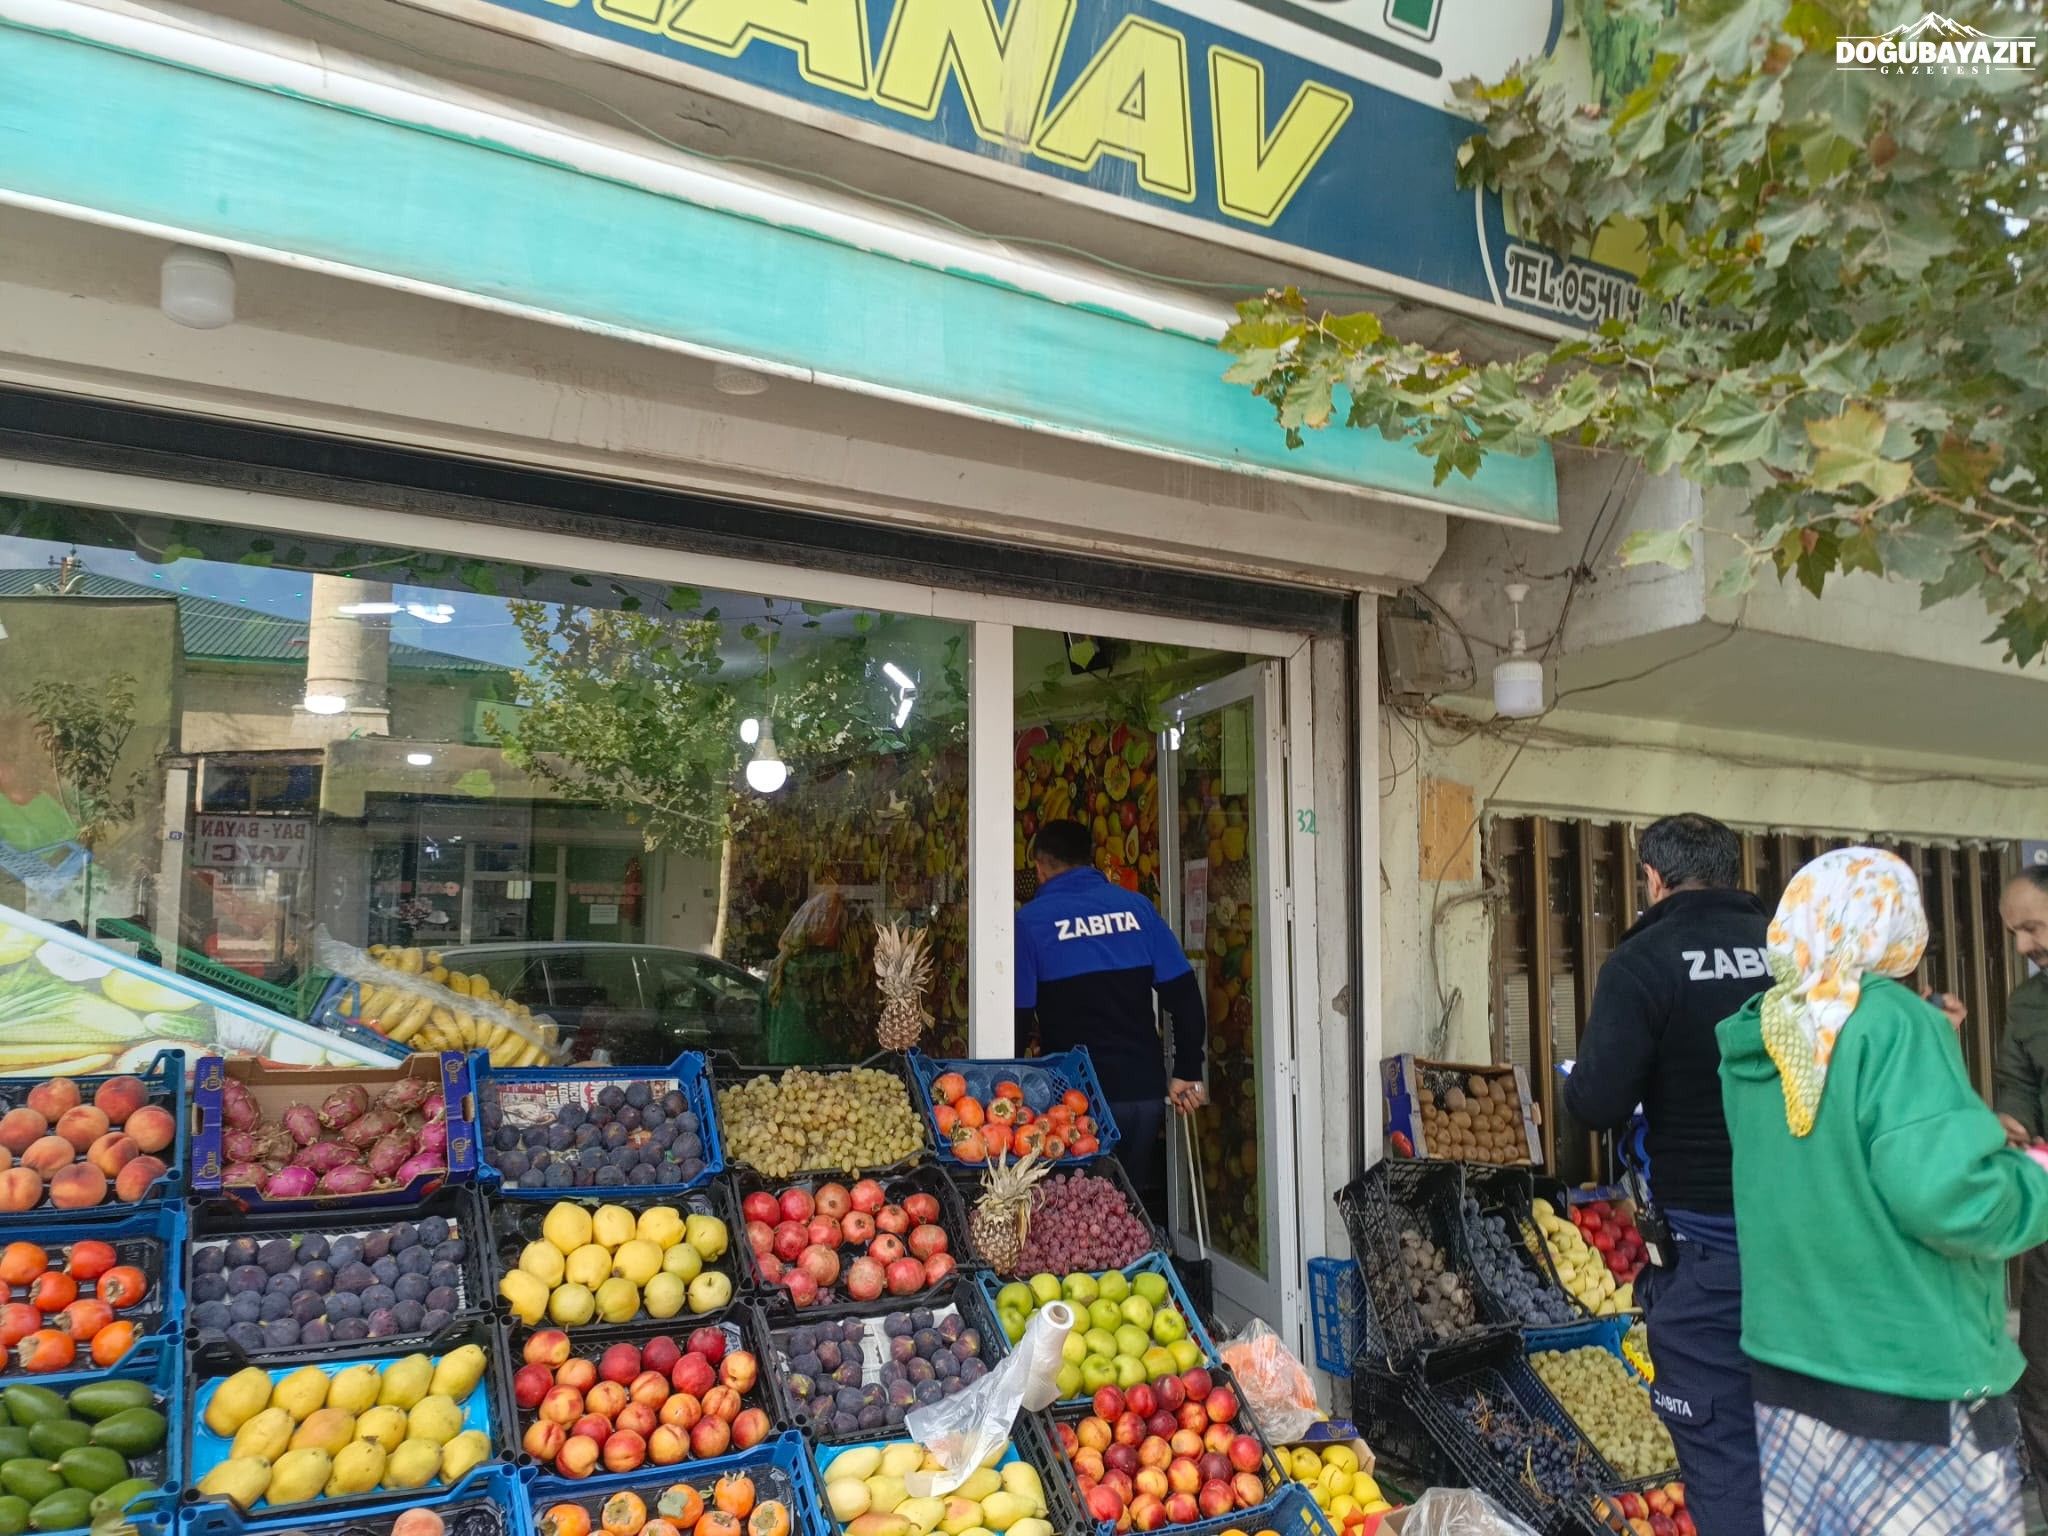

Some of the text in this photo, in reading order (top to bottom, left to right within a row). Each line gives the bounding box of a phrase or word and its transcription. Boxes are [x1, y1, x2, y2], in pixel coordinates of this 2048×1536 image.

[541, 0, 1354, 226] NAV
[1054, 911, 1141, 941] ZABITA
[1653, 1389, 1693, 1418] ZABITA
